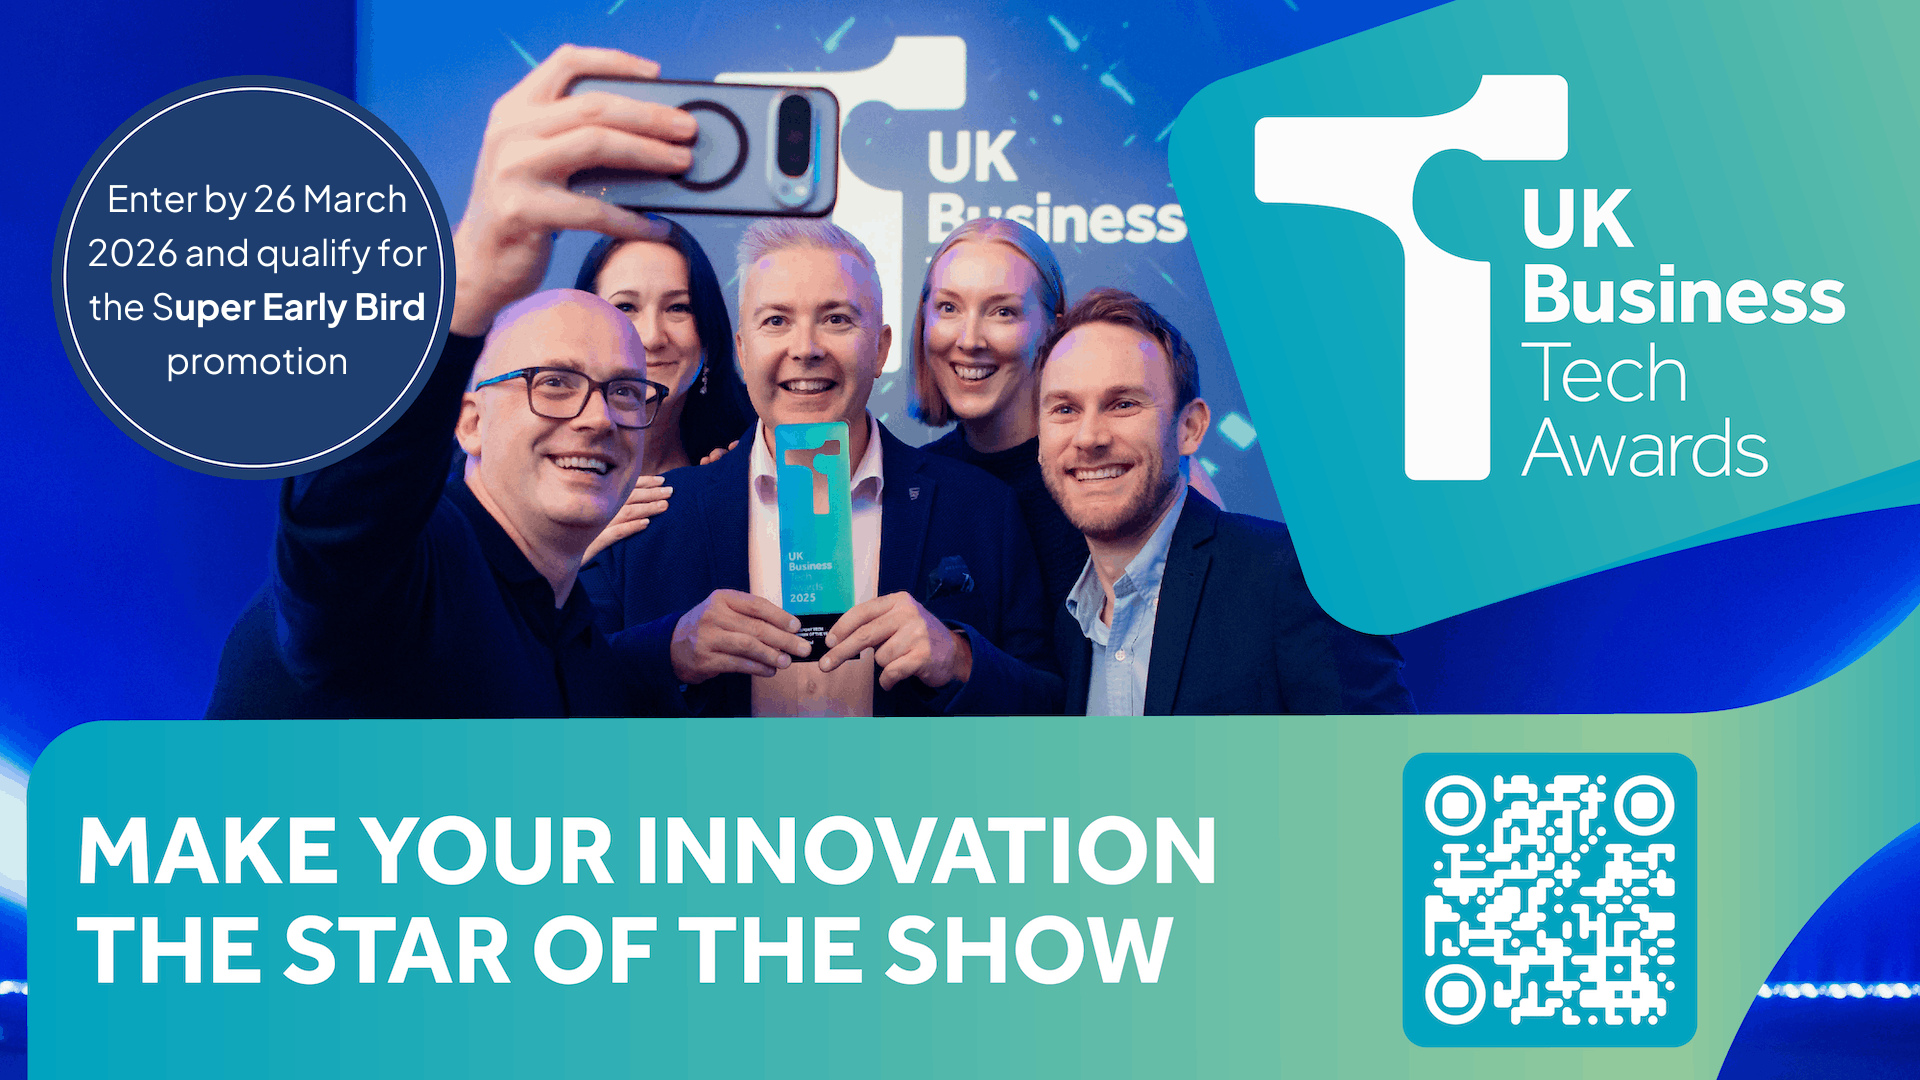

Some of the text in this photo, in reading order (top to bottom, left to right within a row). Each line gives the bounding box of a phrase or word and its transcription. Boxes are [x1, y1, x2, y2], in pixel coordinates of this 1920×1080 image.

[928, 130, 1018, 183] UK
[788, 551, 804, 561] UK
[789, 562, 833, 571] Business
[790, 592, 816, 603] 2025
